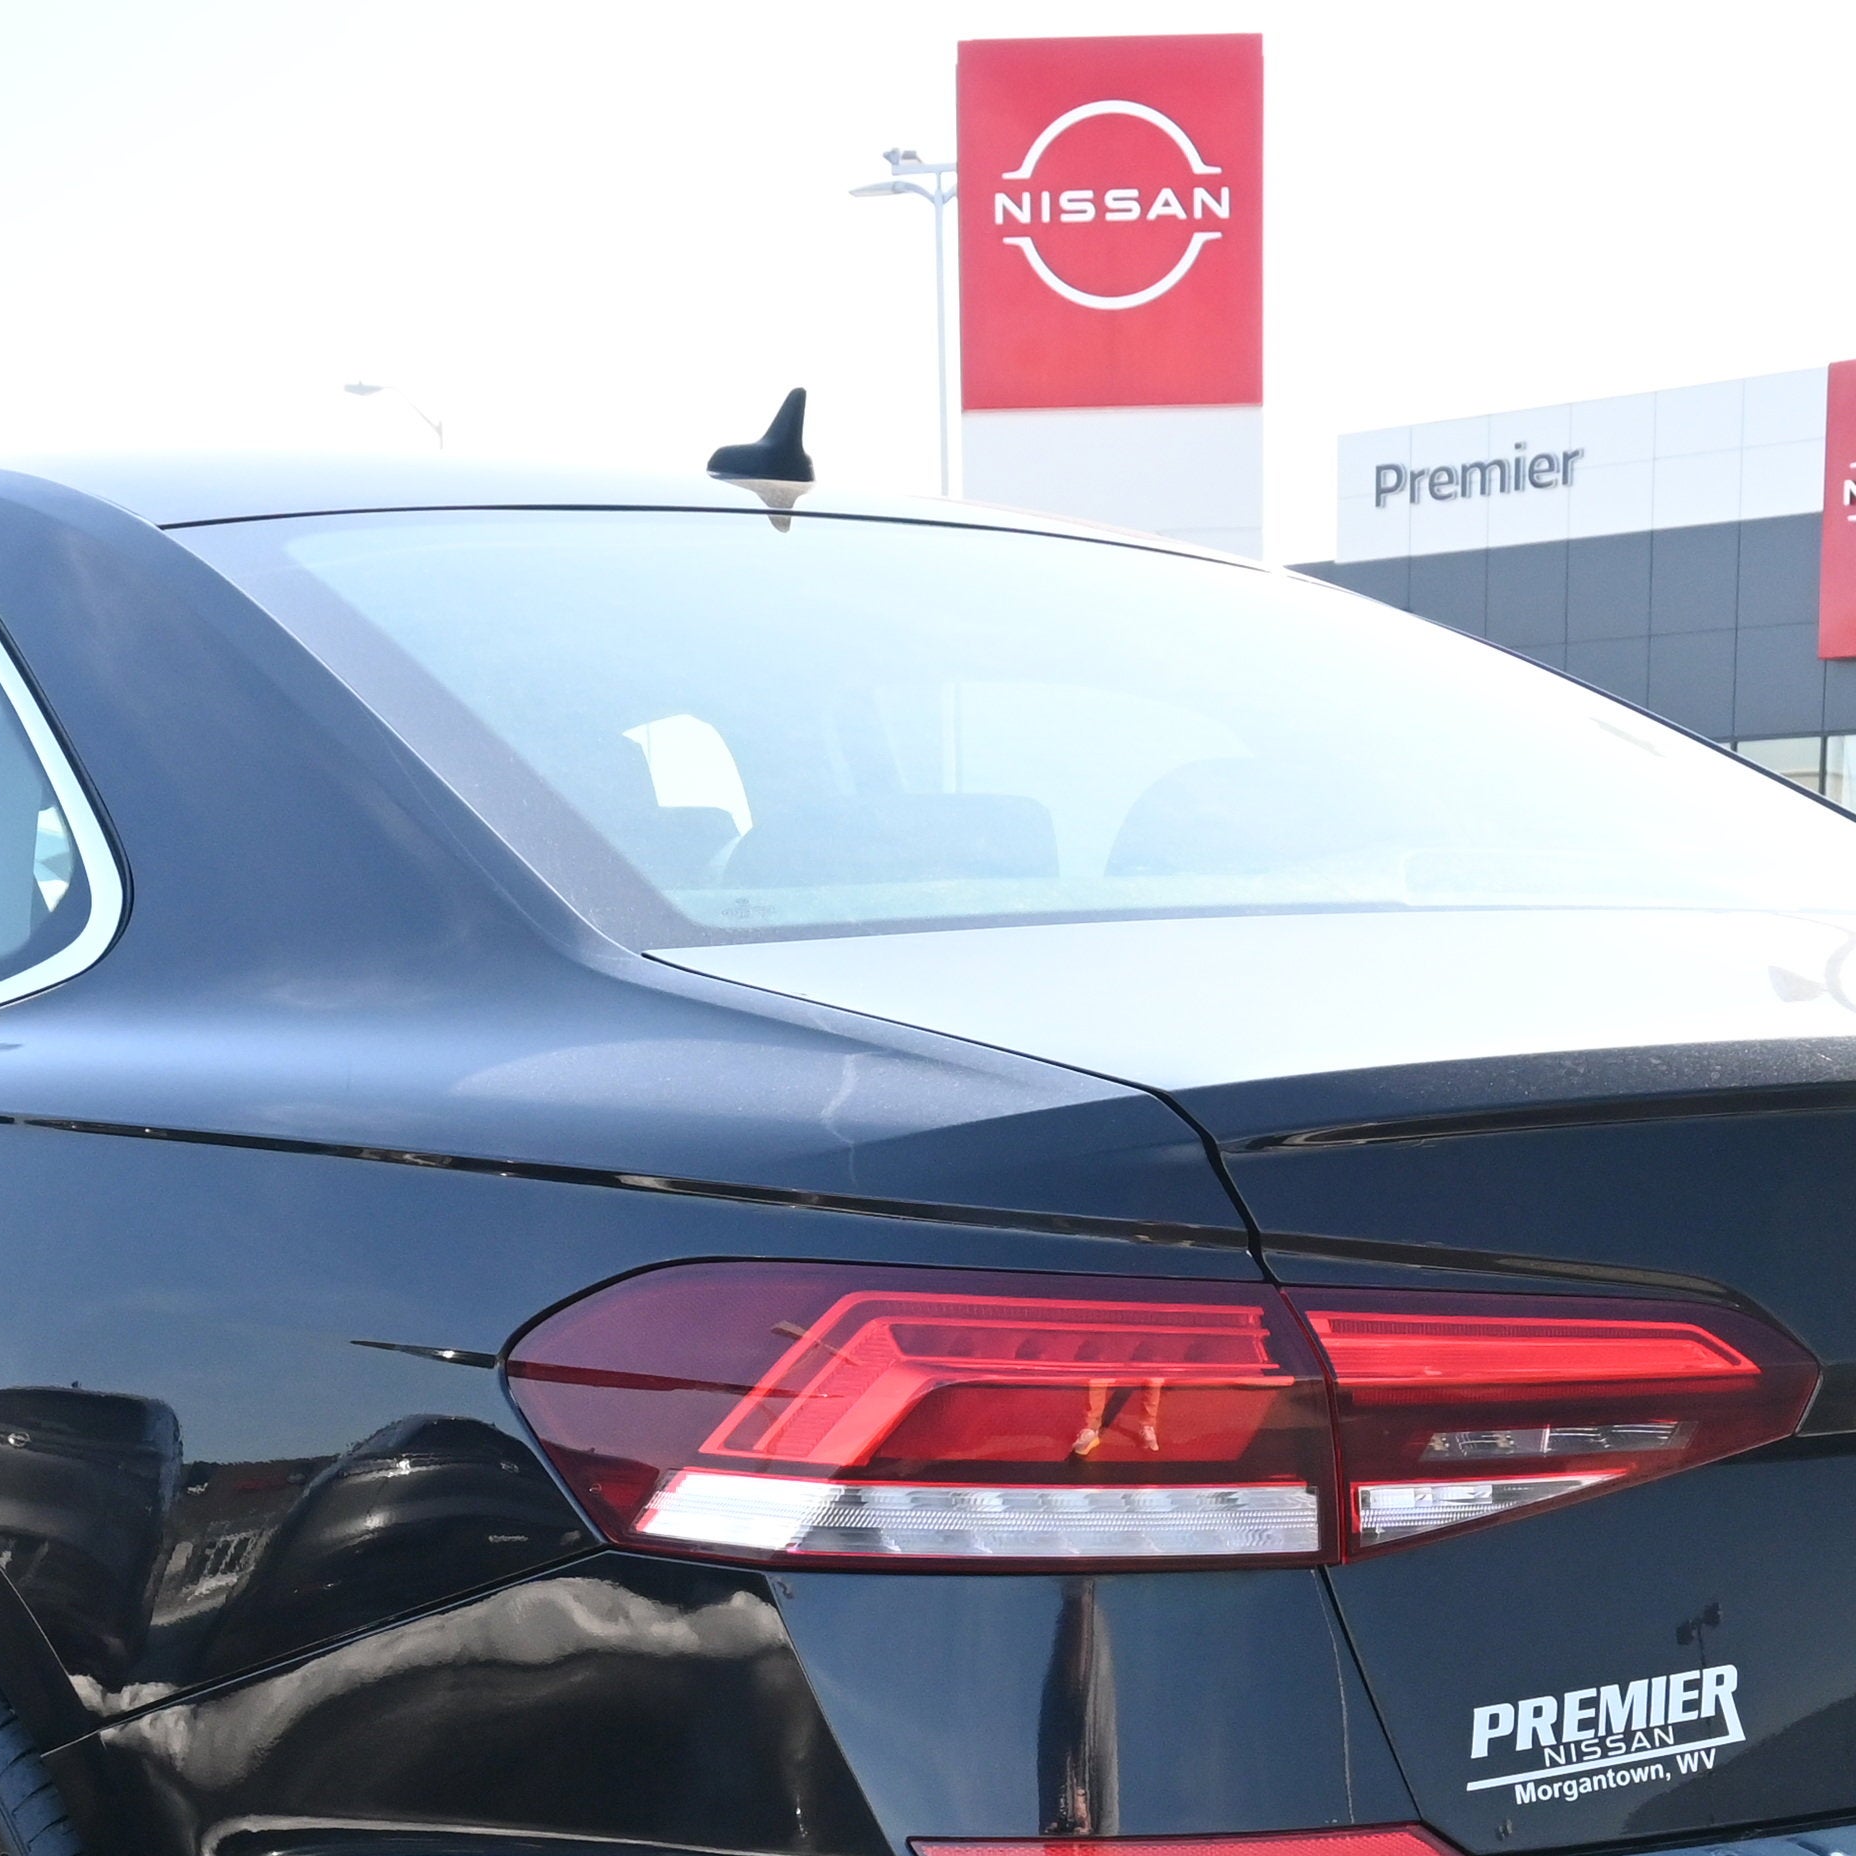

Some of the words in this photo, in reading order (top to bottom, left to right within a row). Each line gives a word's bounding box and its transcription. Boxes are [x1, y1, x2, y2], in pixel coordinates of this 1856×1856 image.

[994, 185, 1230, 224] NISSAN
[1375, 441, 1584, 508] Premier
[1470, 1664, 1746, 1759] PREMIER
[1543, 1725, 1675, 1768] NISSAN
[1515, 1761, 1672, 1805] Morgantown,
[1676, 1748, 1717, 1775] WV
